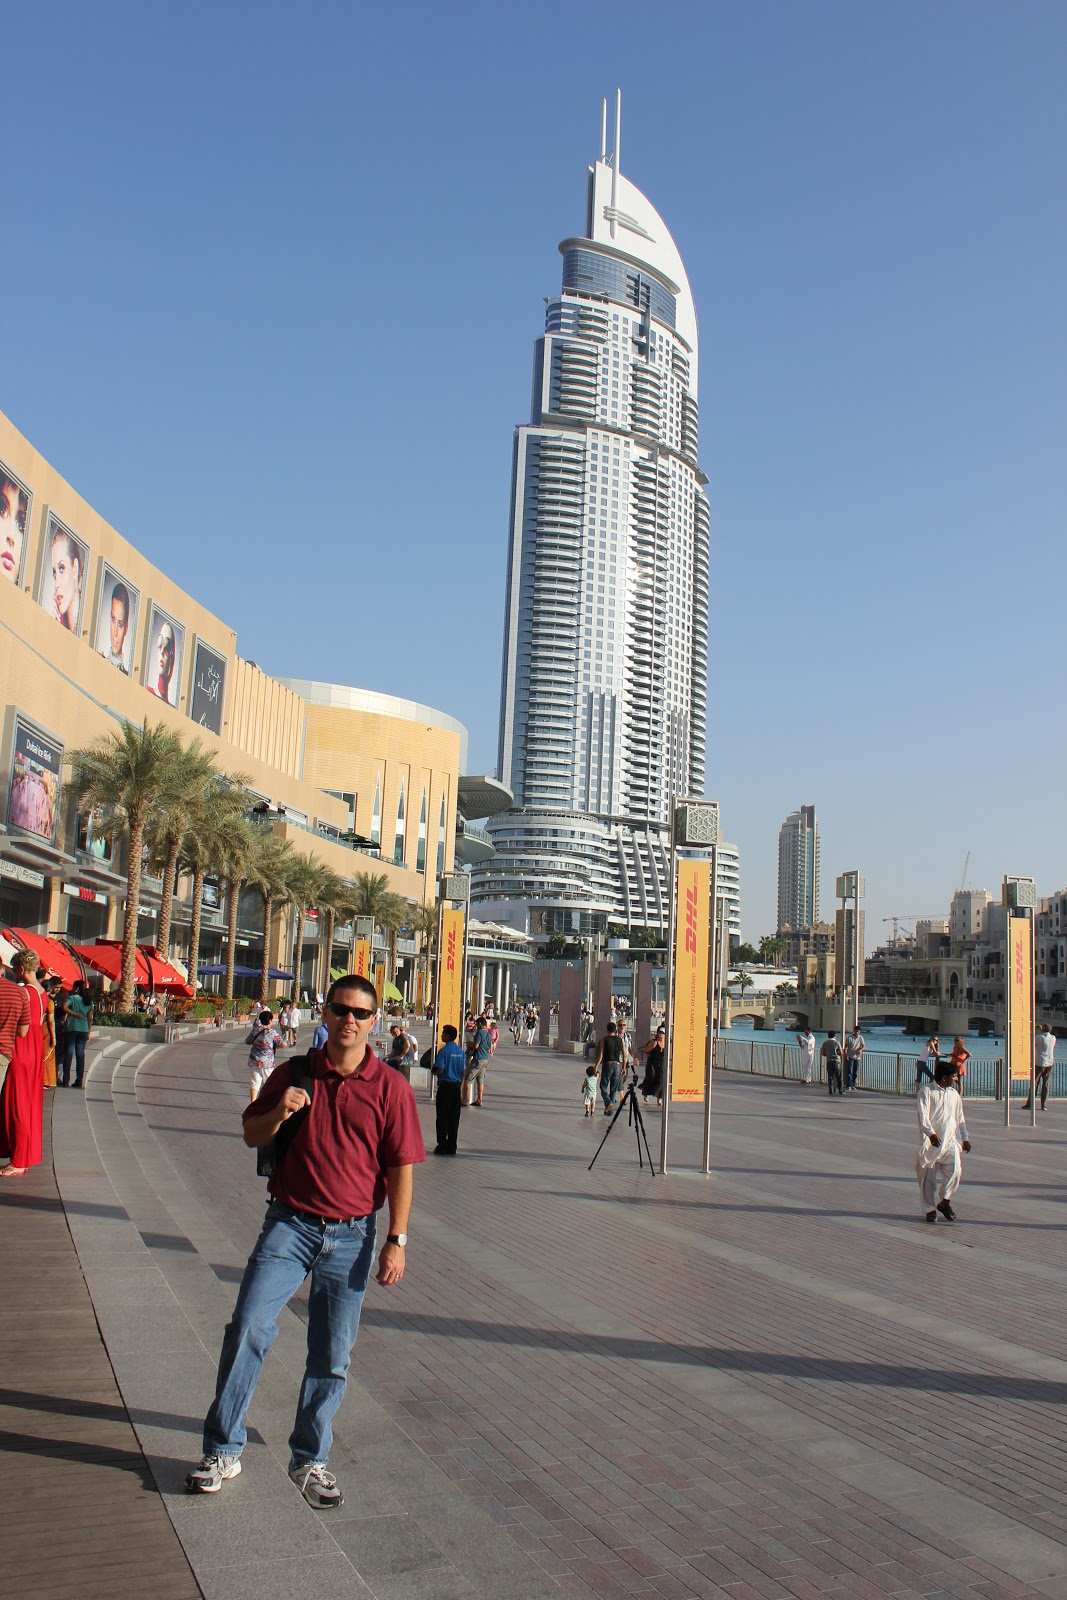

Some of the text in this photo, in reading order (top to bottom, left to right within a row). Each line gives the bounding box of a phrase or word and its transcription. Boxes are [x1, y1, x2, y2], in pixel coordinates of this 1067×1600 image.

[26, 739, 38, 754] Dubai
[686, 884, 697, 954] DHL
[447, 928, 456, 972] DHL
